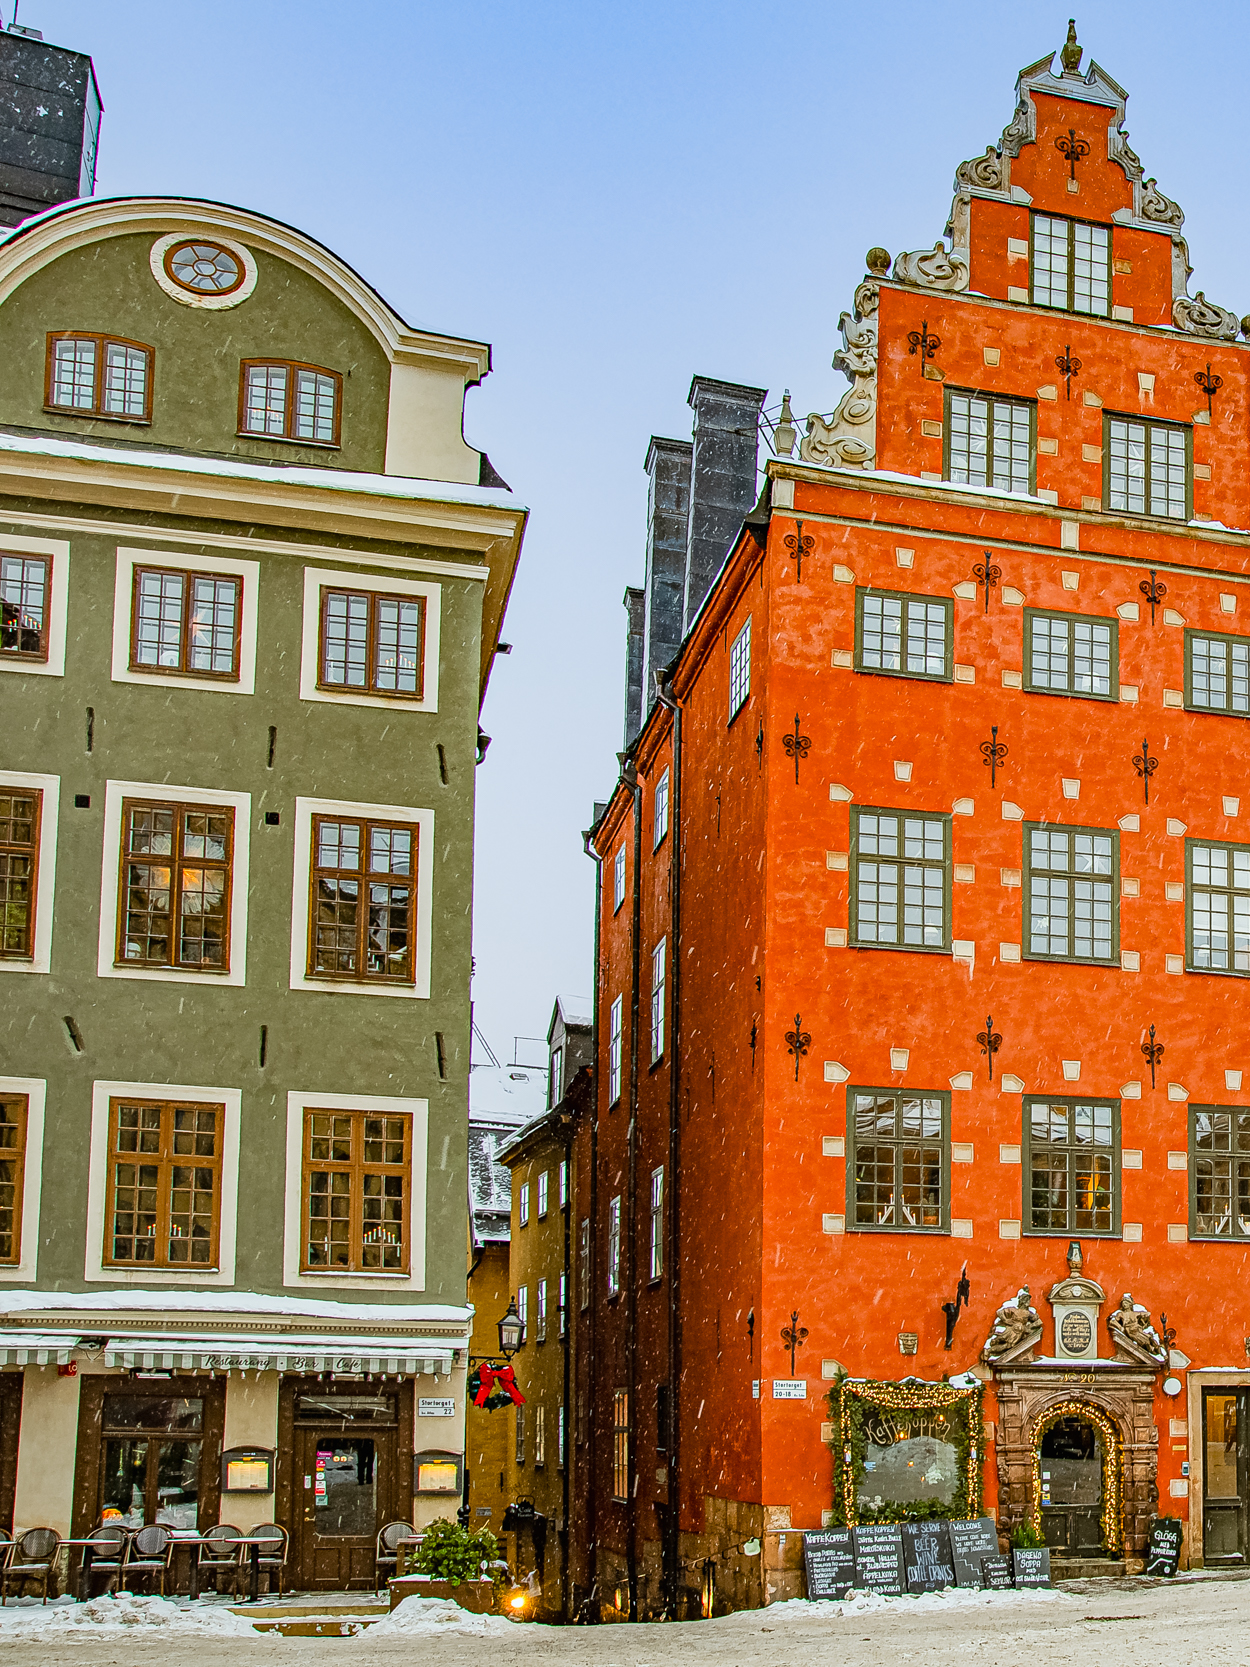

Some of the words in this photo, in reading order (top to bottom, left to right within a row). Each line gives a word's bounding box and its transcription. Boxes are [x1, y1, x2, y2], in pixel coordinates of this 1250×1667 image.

[201, 1354, 272, 1369] Restaurang
[292, 1356, 319, 1369] Bar
[1081, 1373, 1095, 1383] 20
[775, 1382, 802, 1390] Stortorget
[421, 1399, 451, 1407] Stortorget
[907, 1523, 919, 1535] WE
[920, 1522, 941, 1534] SERVE
[953, 1522, 982, 1531] WELCOME
[1154, 1530, 1177, 1543] GLÖGG
[915, 1551, 941, 1566] WINE
[1016, 1551, 1042, 1561] DAGENS
[1020, 1559, 1041, 1569] SOPPA
[907, 1565, 928, 1583] COFFEE
[928, 1564, 954, 1582] DRINKS
